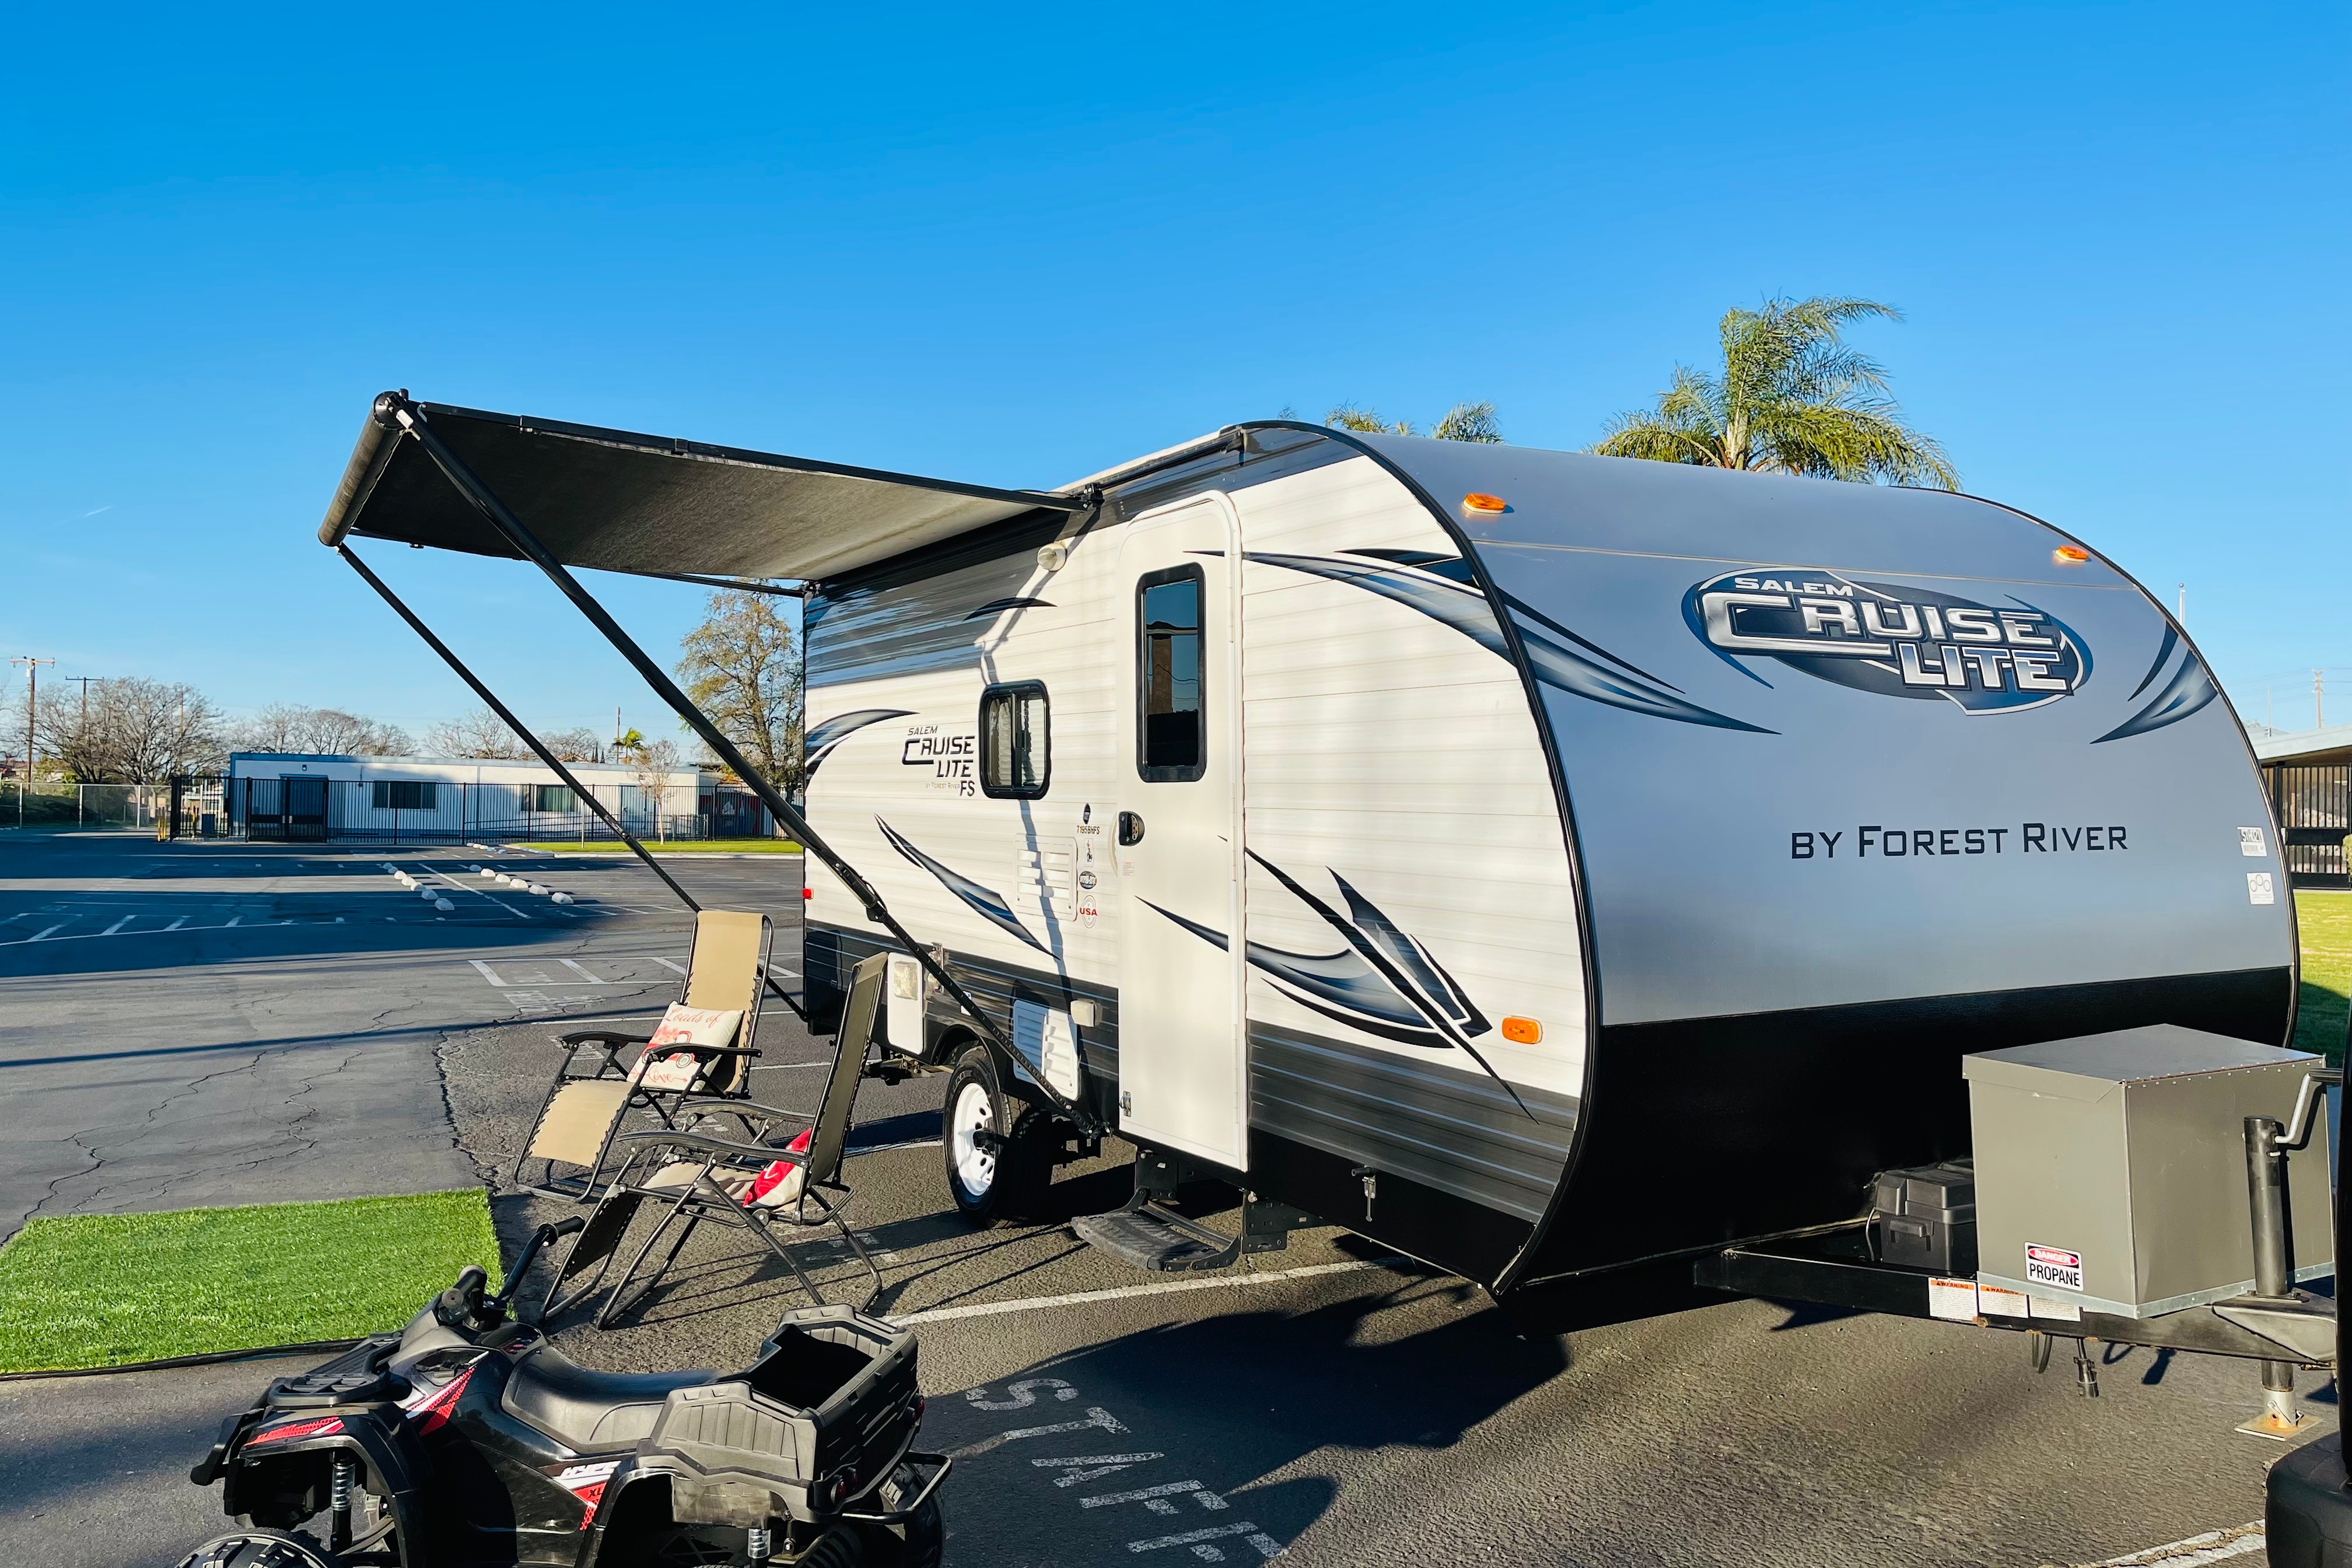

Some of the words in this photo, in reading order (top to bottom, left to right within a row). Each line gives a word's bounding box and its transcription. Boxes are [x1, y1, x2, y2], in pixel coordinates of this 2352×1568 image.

[1735, 577, 1854, 597] SALEM
[1701, 591, 2053, 656] CRUISE
[1898, 642, 2068, 691] LITE
[907, 725, 938, 736] SALEM
[902, 736, 975, 765] CRUISE
[936, 760, 974, 778] LITE
[960, 780, 975, 796] FS
[1791, 831, 1843, 859] BY
[1859, 825, 2008, 858] FOREST
[2022, 822, 2128, 853] RIVER
[1080, 907, 1097, 916] USA
[665, 1007, 702, 1023] Loads
[706, 1011, 725, 1028] of
[2036, 1249, 2071, 1264] DANGER
[1941, 1281, 1968, 1289] WARNING
[2029, 1263, 2080, 1287] PROPANE
[965, 1378, 1289, 1563] STAFF
